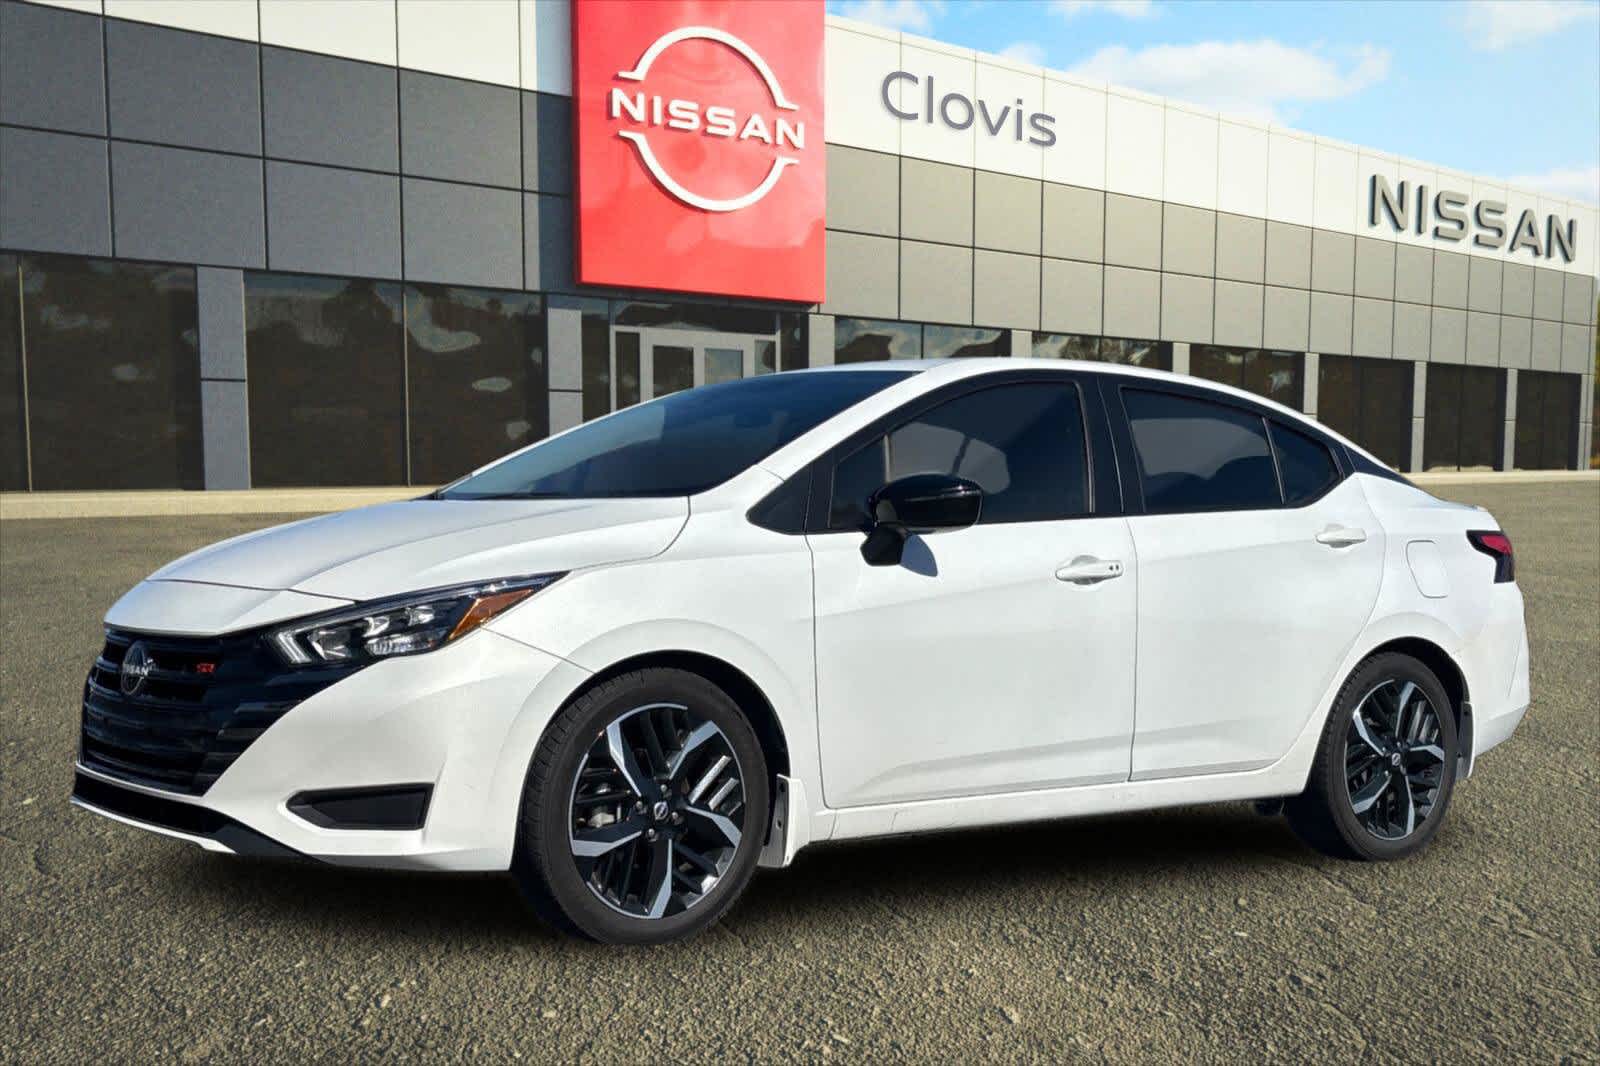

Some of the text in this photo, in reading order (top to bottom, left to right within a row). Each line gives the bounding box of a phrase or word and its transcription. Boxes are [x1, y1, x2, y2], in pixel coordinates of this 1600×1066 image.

[610, 87, 805, 149] NISSAN
[881, 71, 1057, 147] Clovis
[1369, 173, 1577, 263] NISSAN
